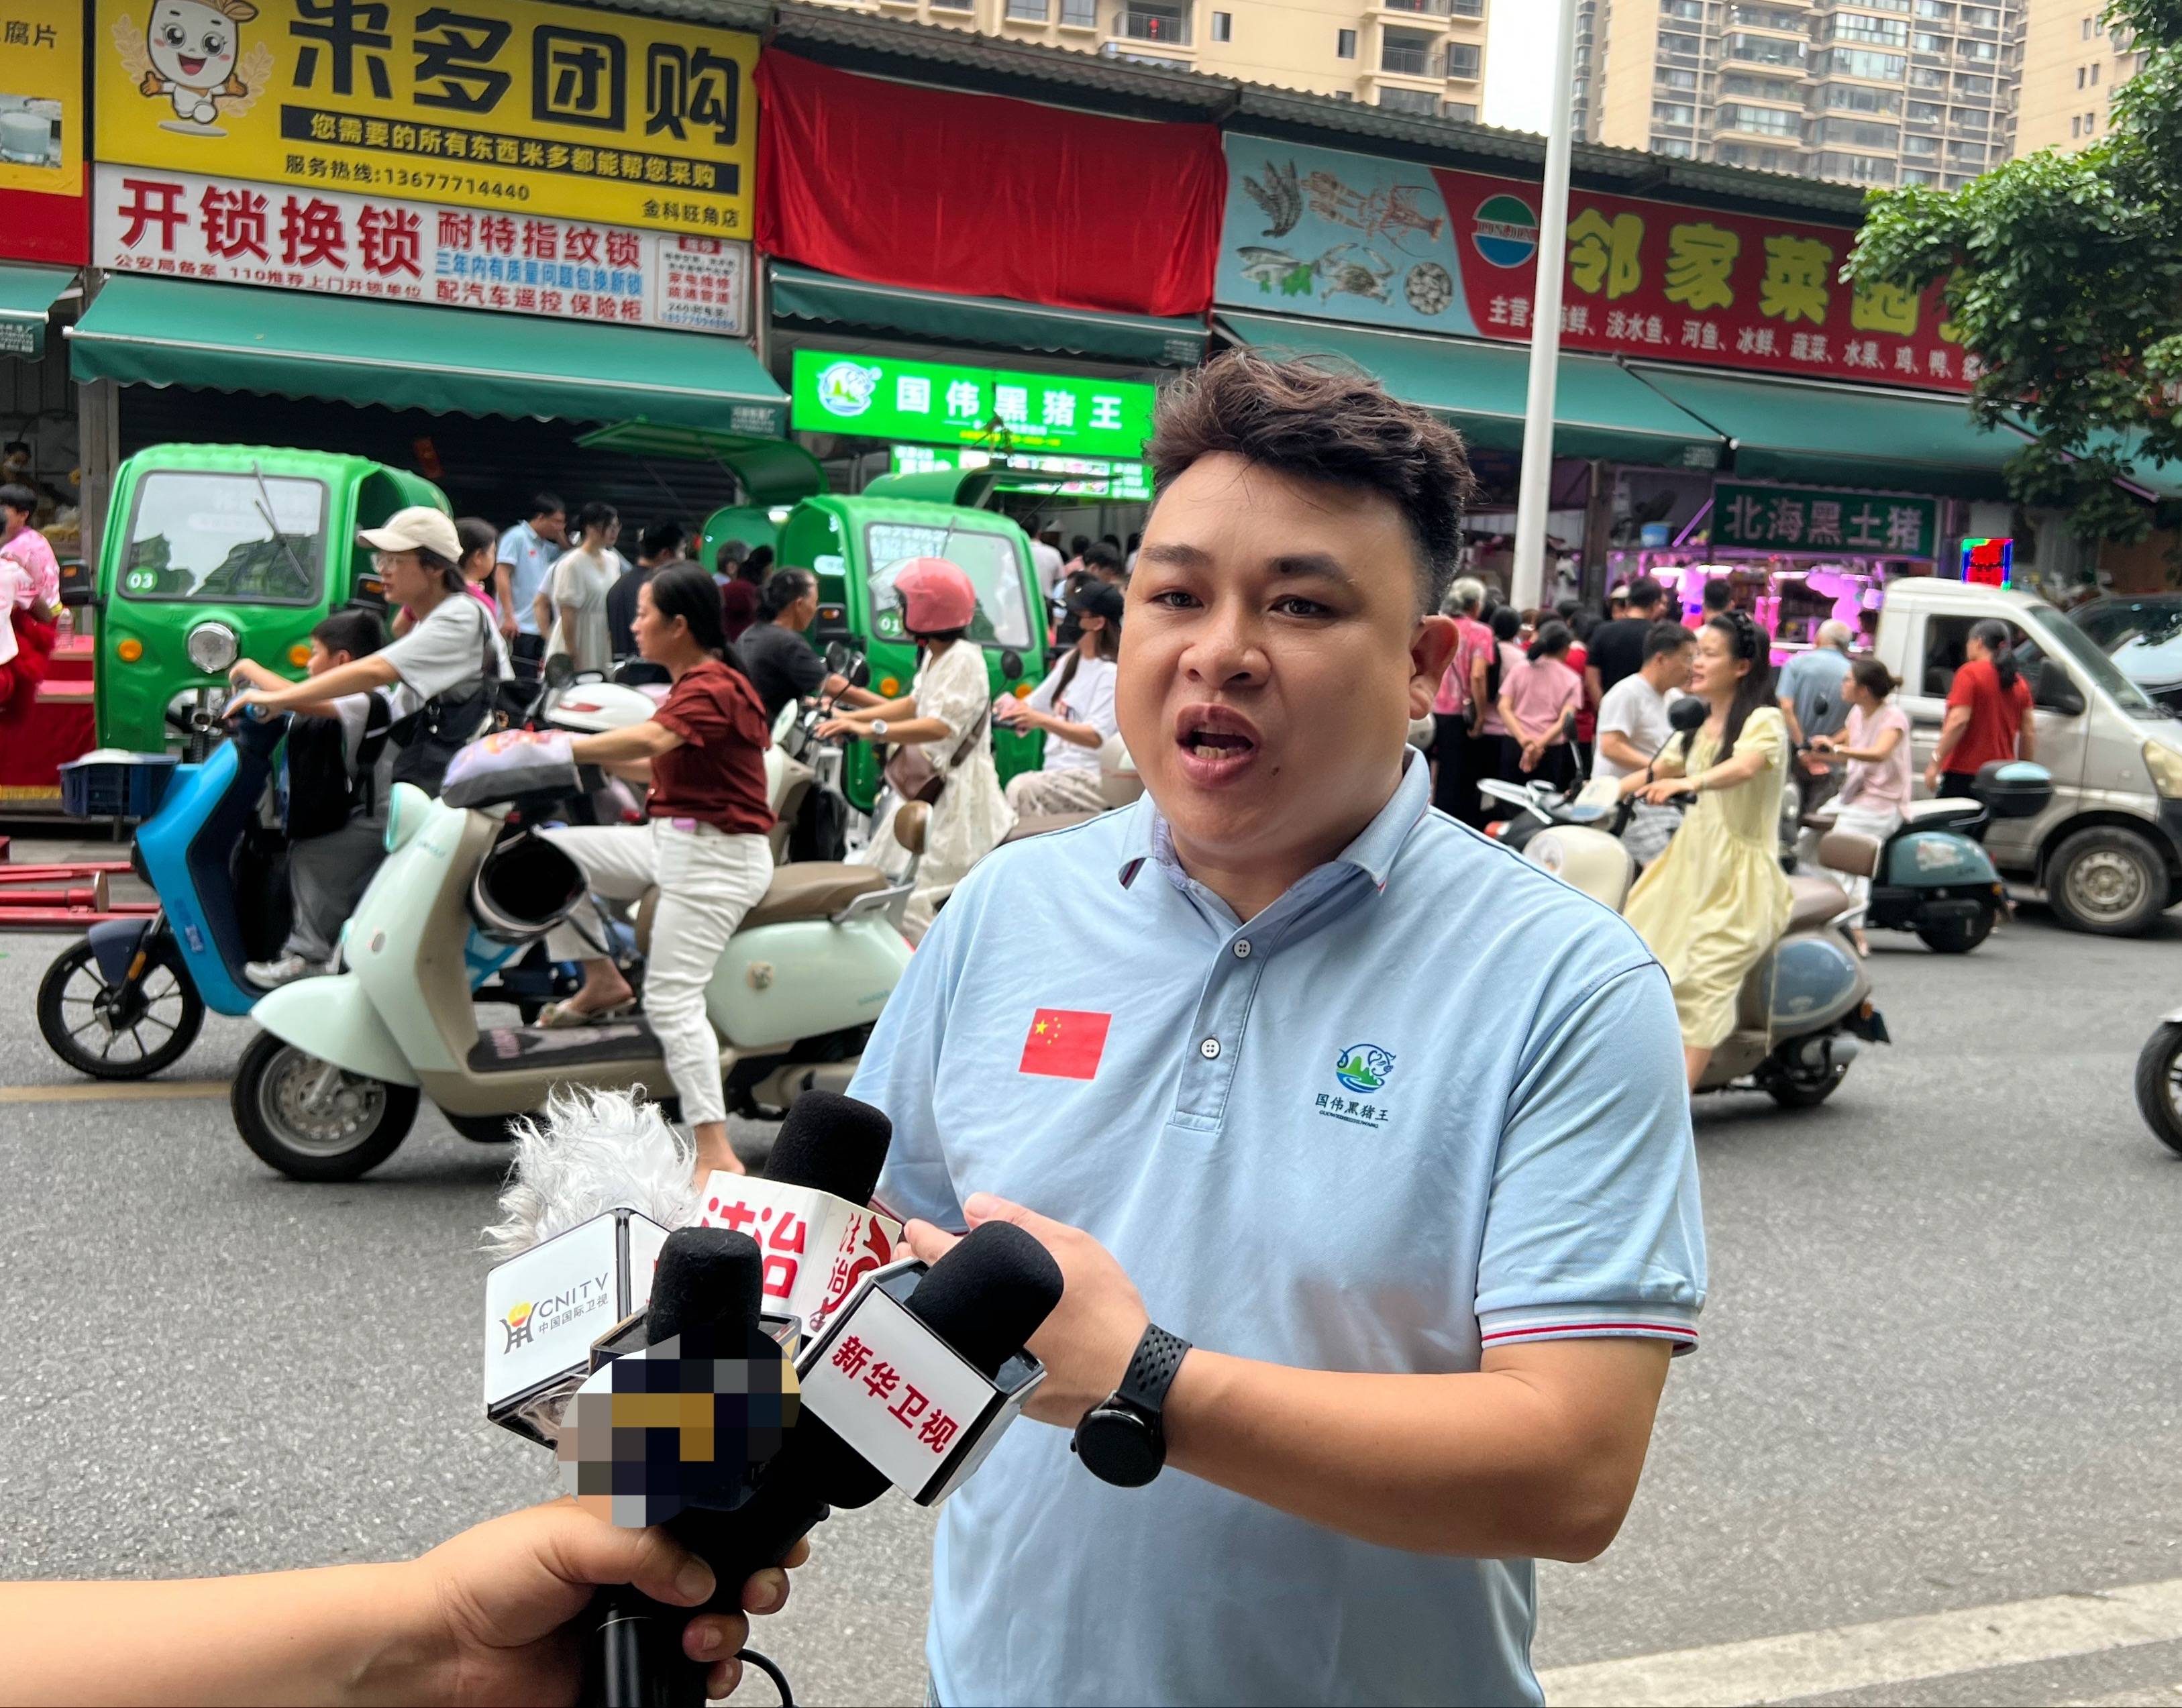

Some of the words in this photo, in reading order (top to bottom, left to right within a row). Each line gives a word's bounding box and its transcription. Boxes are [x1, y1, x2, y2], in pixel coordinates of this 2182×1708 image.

[290, 0, 739, 147] 米多团购
[311, 113, 716, 189] 您需要的所有东西米多都能帮您采购
[117, 177, 424, 279] 开锁换锁
[437, 211, 643, 268] 耐特指纹锁
[642, 199, 739, 227] 金科旺角店
[896, 375, 1123, 430] 国伟黑猪王
[1724, 494, 1922, 551] 北海黑土猪
[130, 573, 154, 589] 03
[880, 616, 902, 633] 01
[1315, 1093, 1389, 1121] 国伟黑猪王
[539, 1272, 609, 1318] CNITV
[539, 1293, 609, 1334] 中国国际卫视
[831, 1335, 959, 1453] 新华卫视
